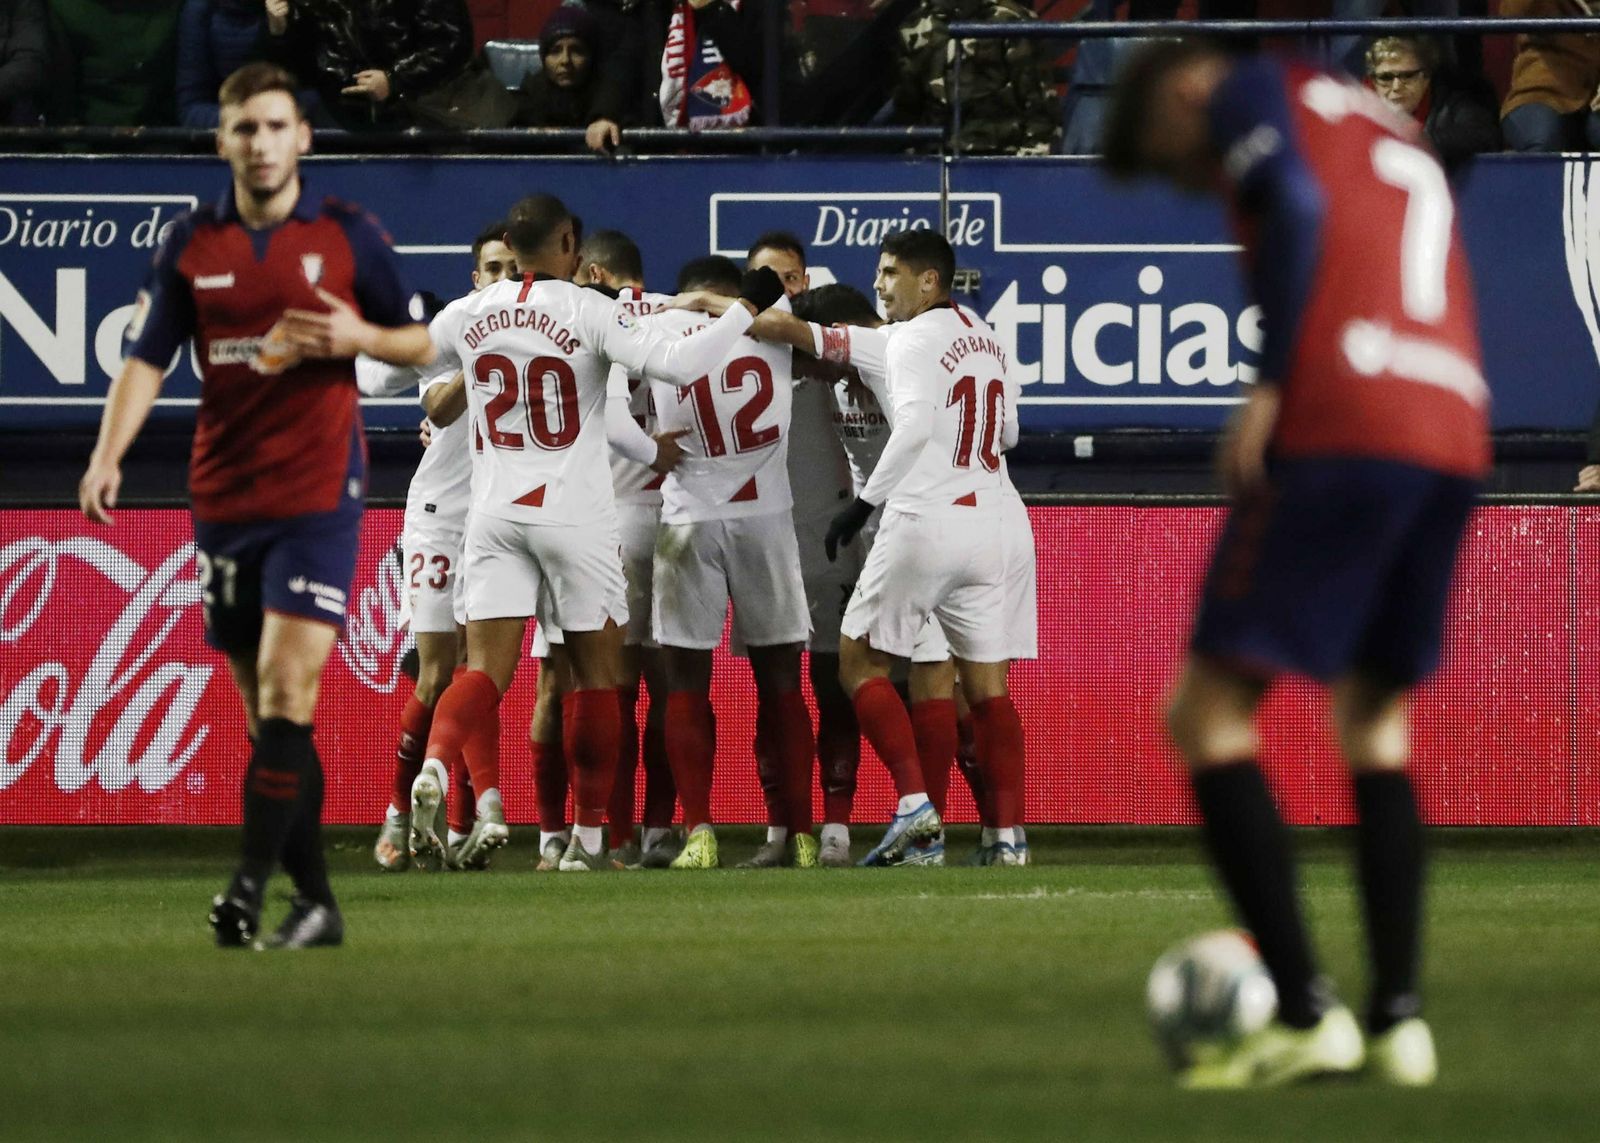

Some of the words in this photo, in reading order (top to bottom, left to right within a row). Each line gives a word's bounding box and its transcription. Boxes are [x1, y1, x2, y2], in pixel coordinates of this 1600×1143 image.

[0, 207, 118, 247] Diario
[947, 203, 986, 246] de
[471, 353, 585, 454] 20
[676, 355, 781, 458] 12
[945, 375, 1006, 474] 10
[410, 553, 450, 590] 23
